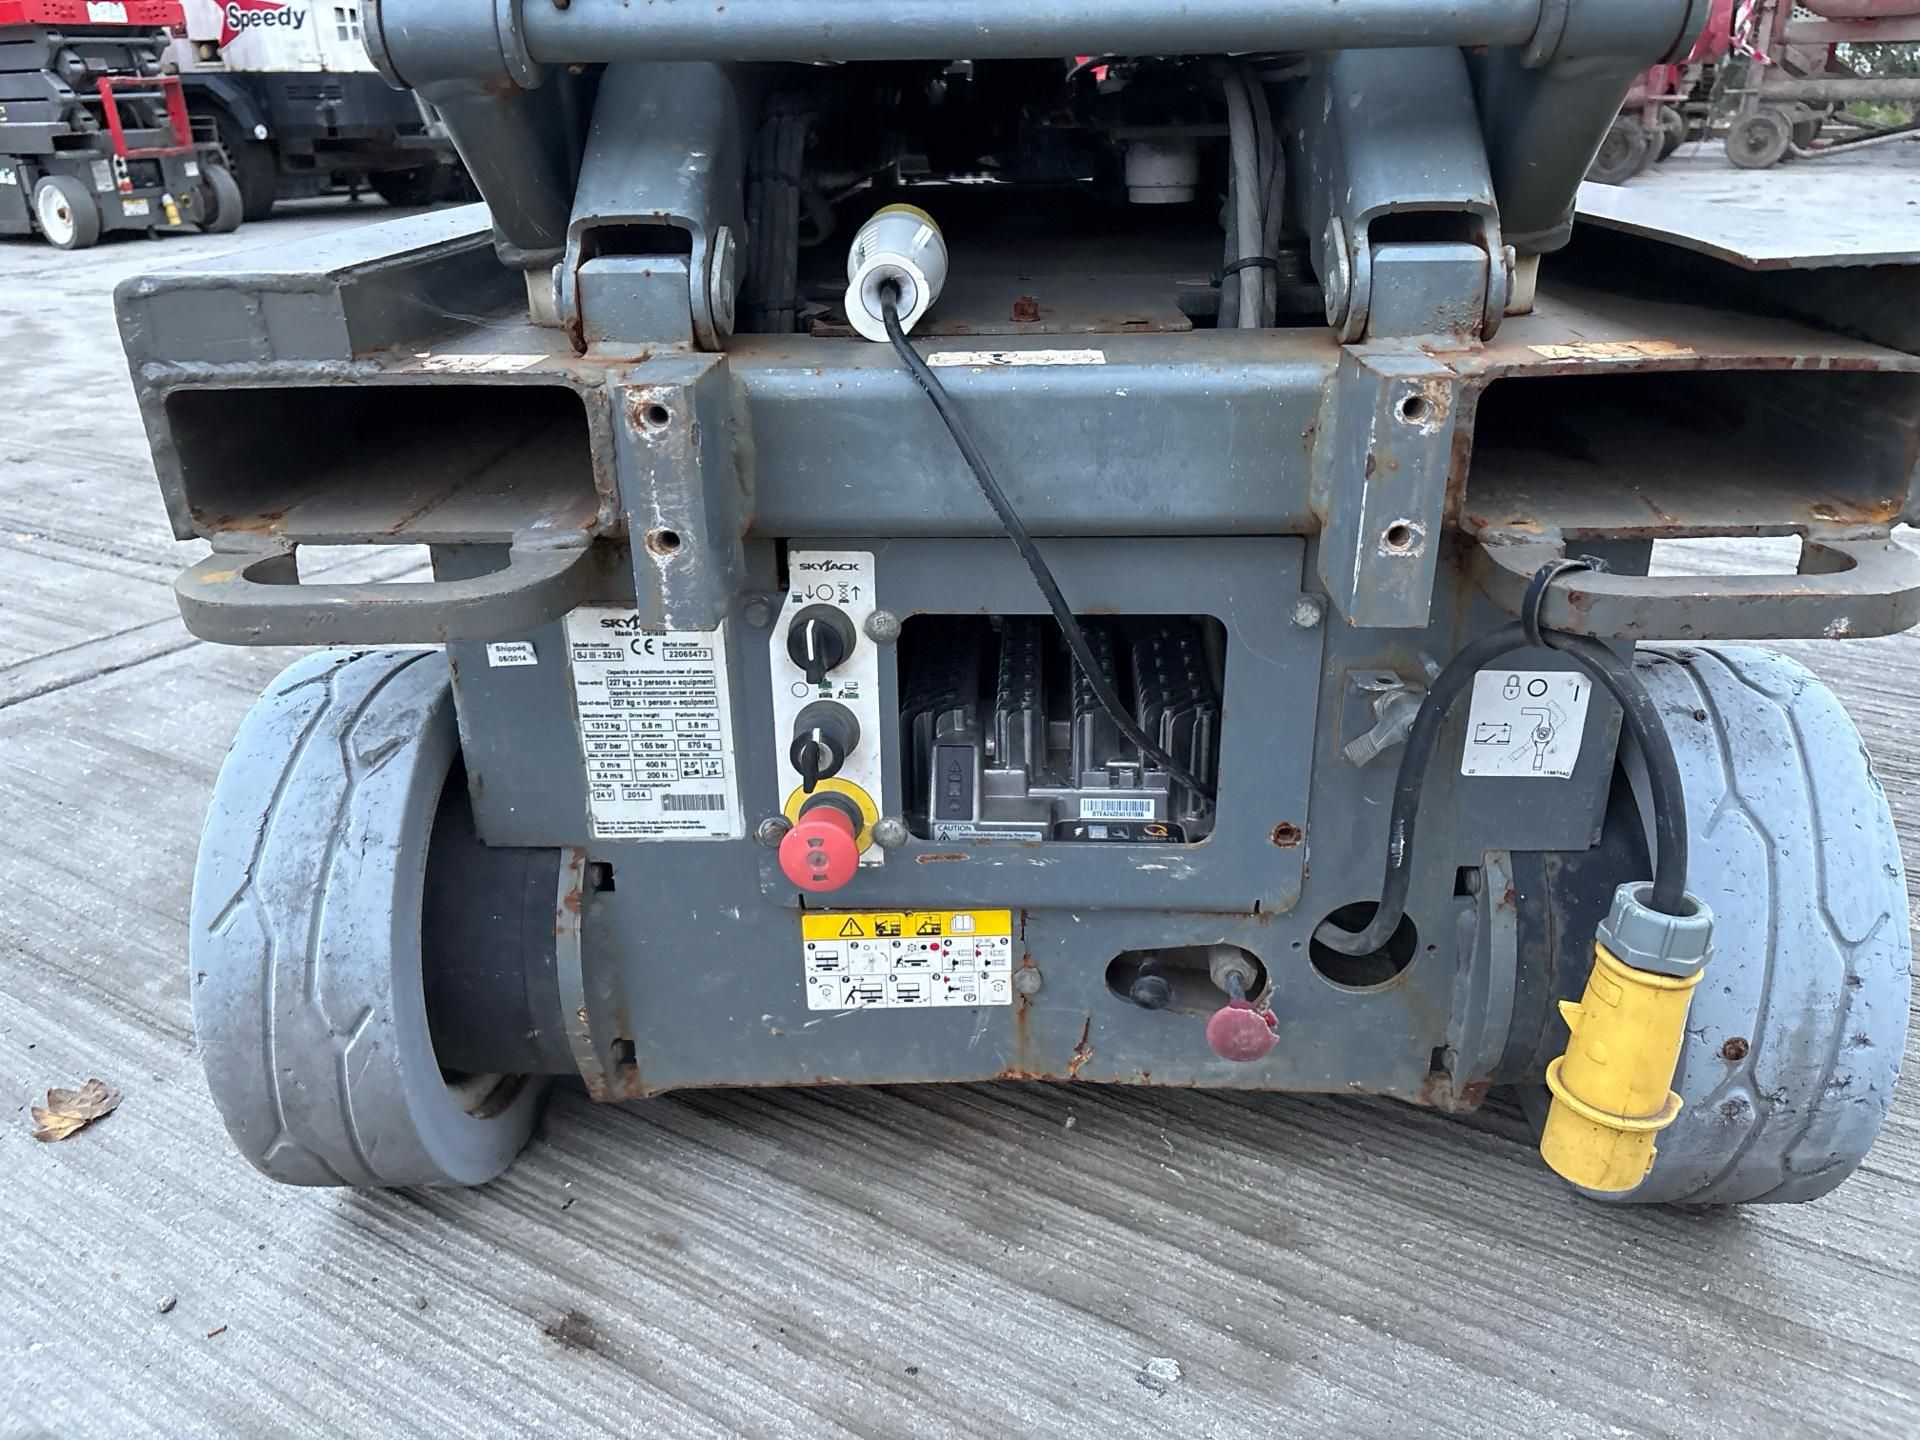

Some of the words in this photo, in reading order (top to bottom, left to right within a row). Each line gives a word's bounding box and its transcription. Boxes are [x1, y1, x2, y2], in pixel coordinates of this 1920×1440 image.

[228, 4, 306, 31] Speedy
[800, 560, 860, 572] SKYJACK
[631, 639, 654, 655] CE
